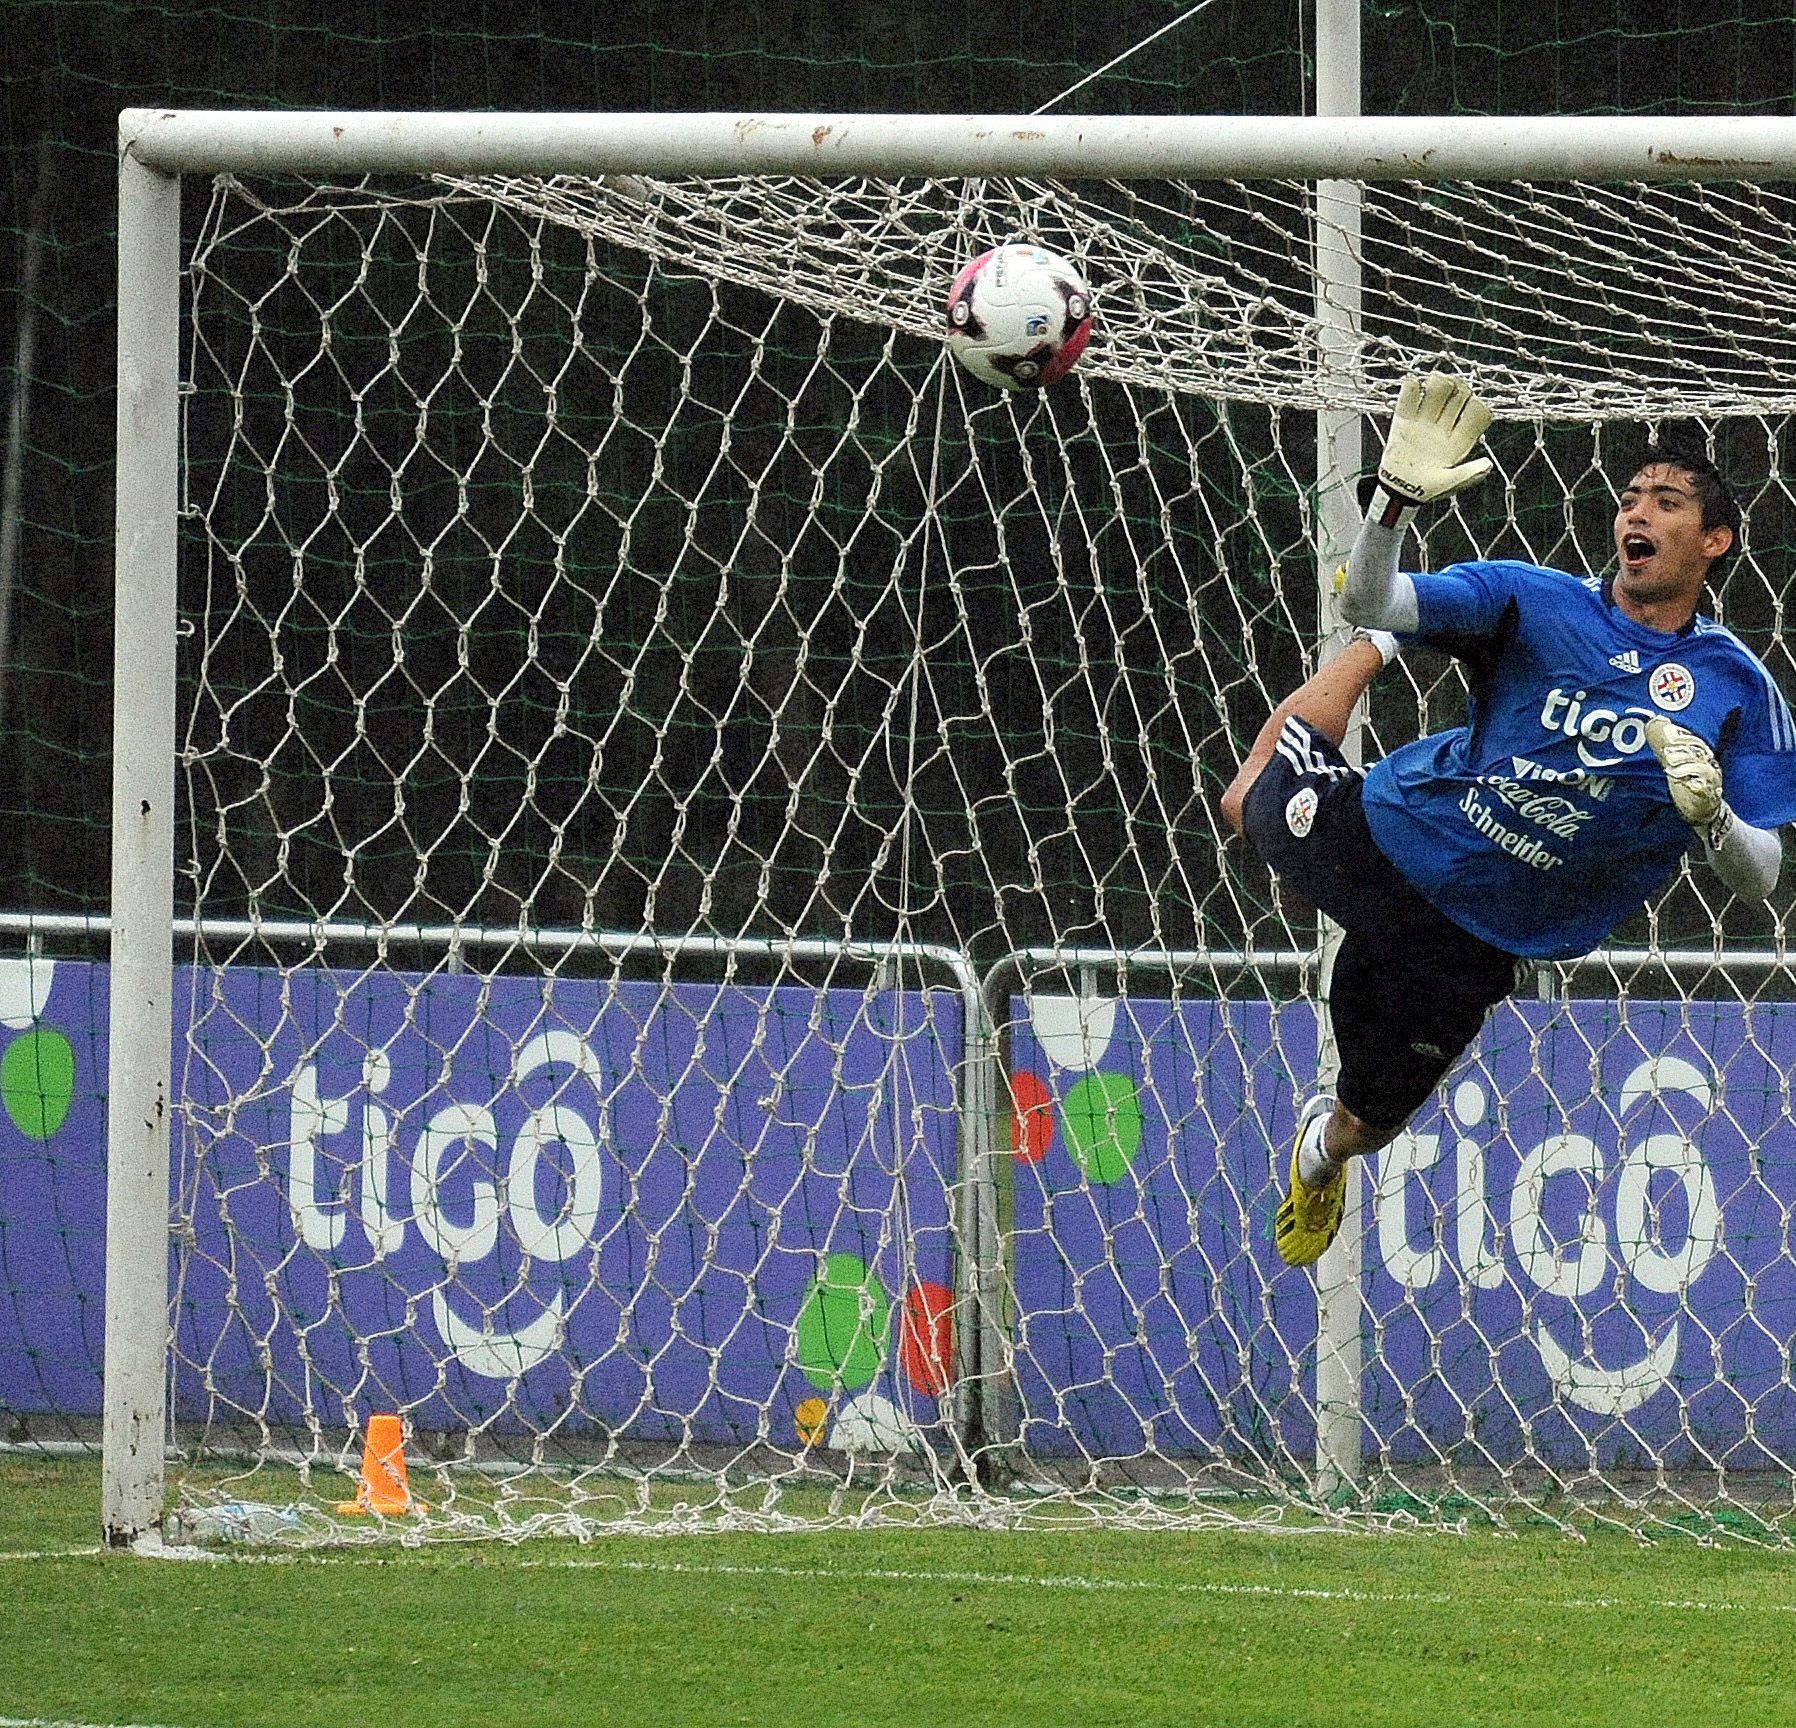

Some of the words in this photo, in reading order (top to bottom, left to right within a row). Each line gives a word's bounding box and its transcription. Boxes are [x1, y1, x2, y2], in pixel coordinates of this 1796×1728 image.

[1380, 468, 1425, 497] eusch
[1459, 787, 1563, 870] Schneider
[290, 1031, 602, 1378] tigo
[1377, 1056, 1719, 1416] tigo
